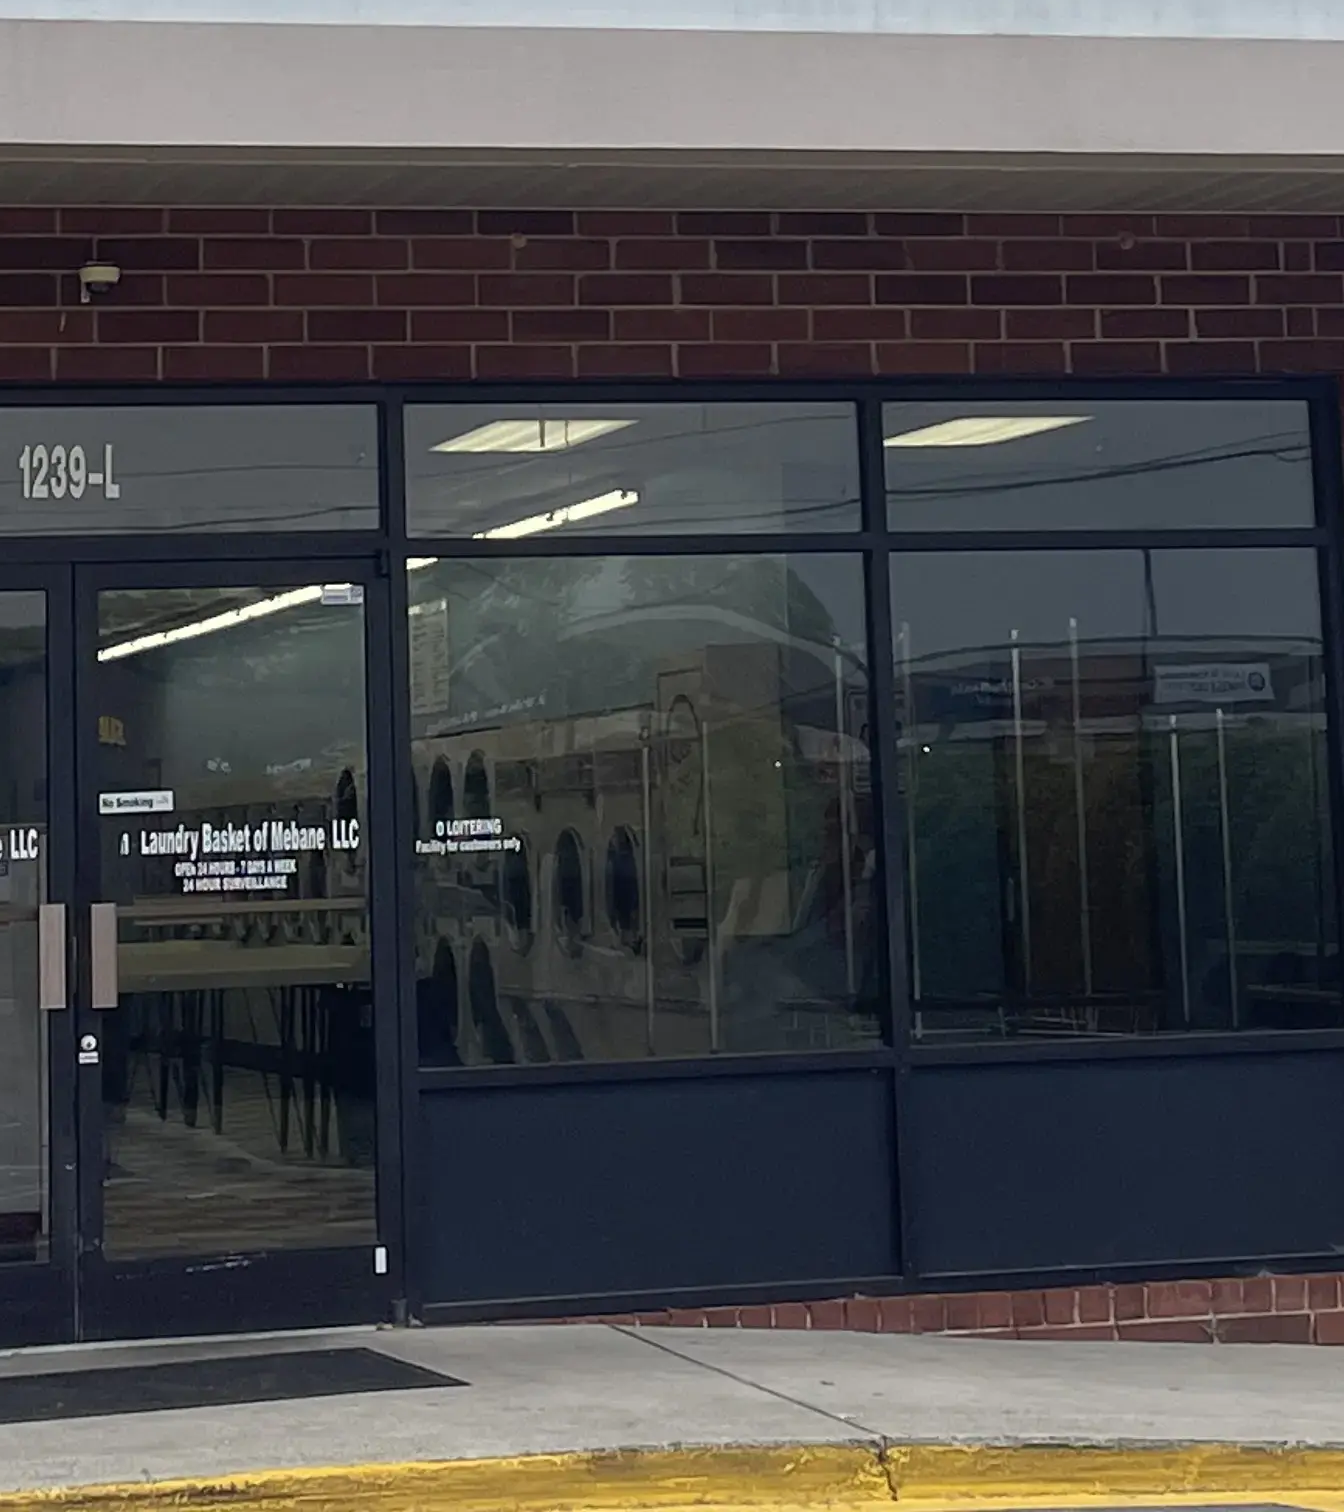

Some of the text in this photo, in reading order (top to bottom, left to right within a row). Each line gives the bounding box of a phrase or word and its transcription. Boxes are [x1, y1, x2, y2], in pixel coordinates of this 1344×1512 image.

[19, 444, 120, 499] 1239-L
[10, 828, 38, 859] LLC
[141, 824, 199, 861] Laundry
[202, 822, 250, 853] Basket
[253, 821, 269, 851] of
[271, 820, 326, 850] Mebane
[332, 818, 359, 849] LLC
[446, 819, 502, 836] LOITERING
